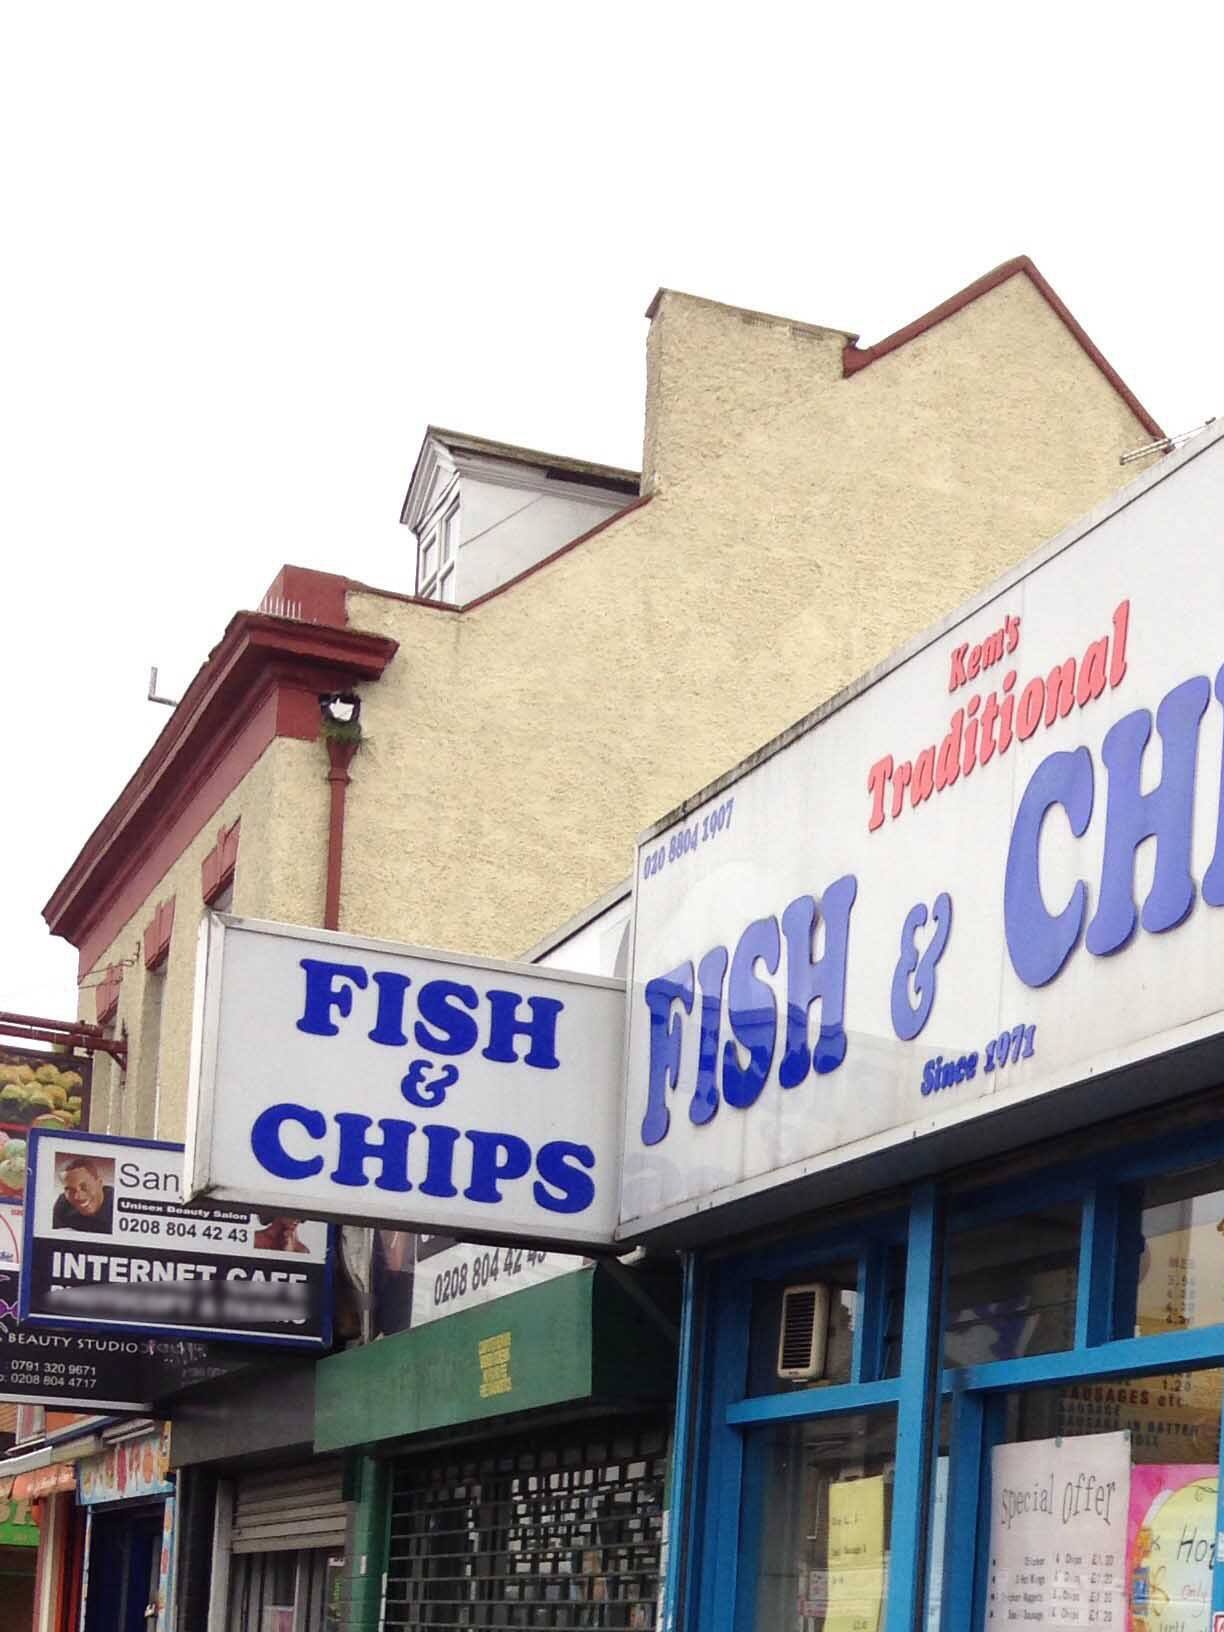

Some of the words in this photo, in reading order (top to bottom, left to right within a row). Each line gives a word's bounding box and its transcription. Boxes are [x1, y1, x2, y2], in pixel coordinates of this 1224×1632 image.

[948, 614, 1021, 694] Kem's
[868, 599, 1130, 831] Traditional
[643, 848, 666, 880] 020
[702, 797, 735, 842] 1907
[296, 958, 565, 1070] FISH
[640, 875, 857, 1146] FISH
[890, 893, 952, 1041] &
[400, 1058, 460, 1109] &
[920, 1051, 979, 1096] Since
[984, 1024, 1036, 1073] 1971
[119, 1163, 181, 1193] San
[250, 1102, 597, 1215] CHIPS
[119, 1217, 160, 1235] 0208
[166, 1221, 198, 1238] 804
[202, 1225, 223, 1241] 42
[228, 1228, 248, 1243] 43
[121, 1201, 163, 1212] Unisex
[167, 1206, 210, 1219] Beauty
[213, 1211, 248, 1221] Salon
[52, 1251, 217, 1285] INTERNET
[434, 1262, 468, 1306] 0208
[472, 1247, 500, 1283] 804
[8, 1333, 73, 1348] BEAUTY
[77, 1338, 139, 1354] STUDIO
[11, 1360, 40, 1372] 0791
[44, 1362, 66, 1374] 320
[10, 1373, 40, 1385] 0208
[68, 1377, 97, 1389] 4717
[1000, 1471, 1054, 1530] special
[1062, 1472, 1116, 1527] offer
